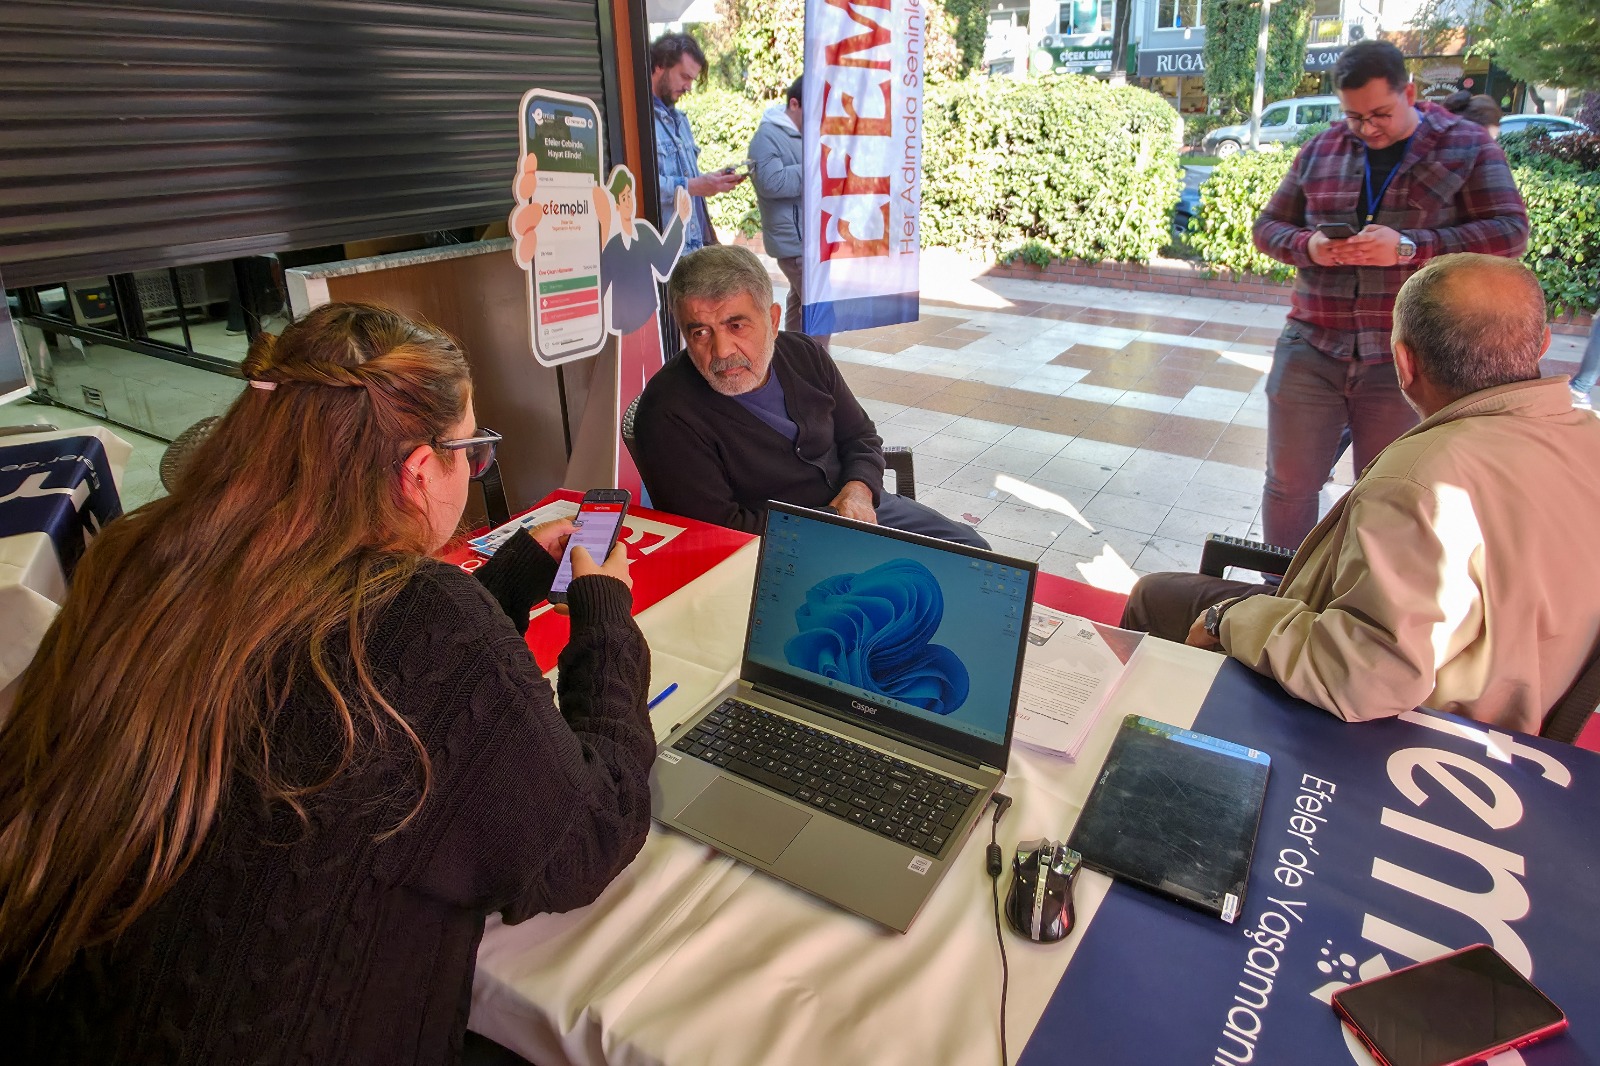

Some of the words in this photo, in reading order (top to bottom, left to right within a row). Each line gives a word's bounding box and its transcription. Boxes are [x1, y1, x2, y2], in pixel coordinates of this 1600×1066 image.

[1059, 49, 1086, 63] ÇİÇEK
[901, 96, 918, 203] Adımda
[542, 199, 589, 216] efemobil
[900, 214, 915, 255] Her
[851, 700, 878, 715] Casper
[1274, 773, 1337, 888] Efeler'de
